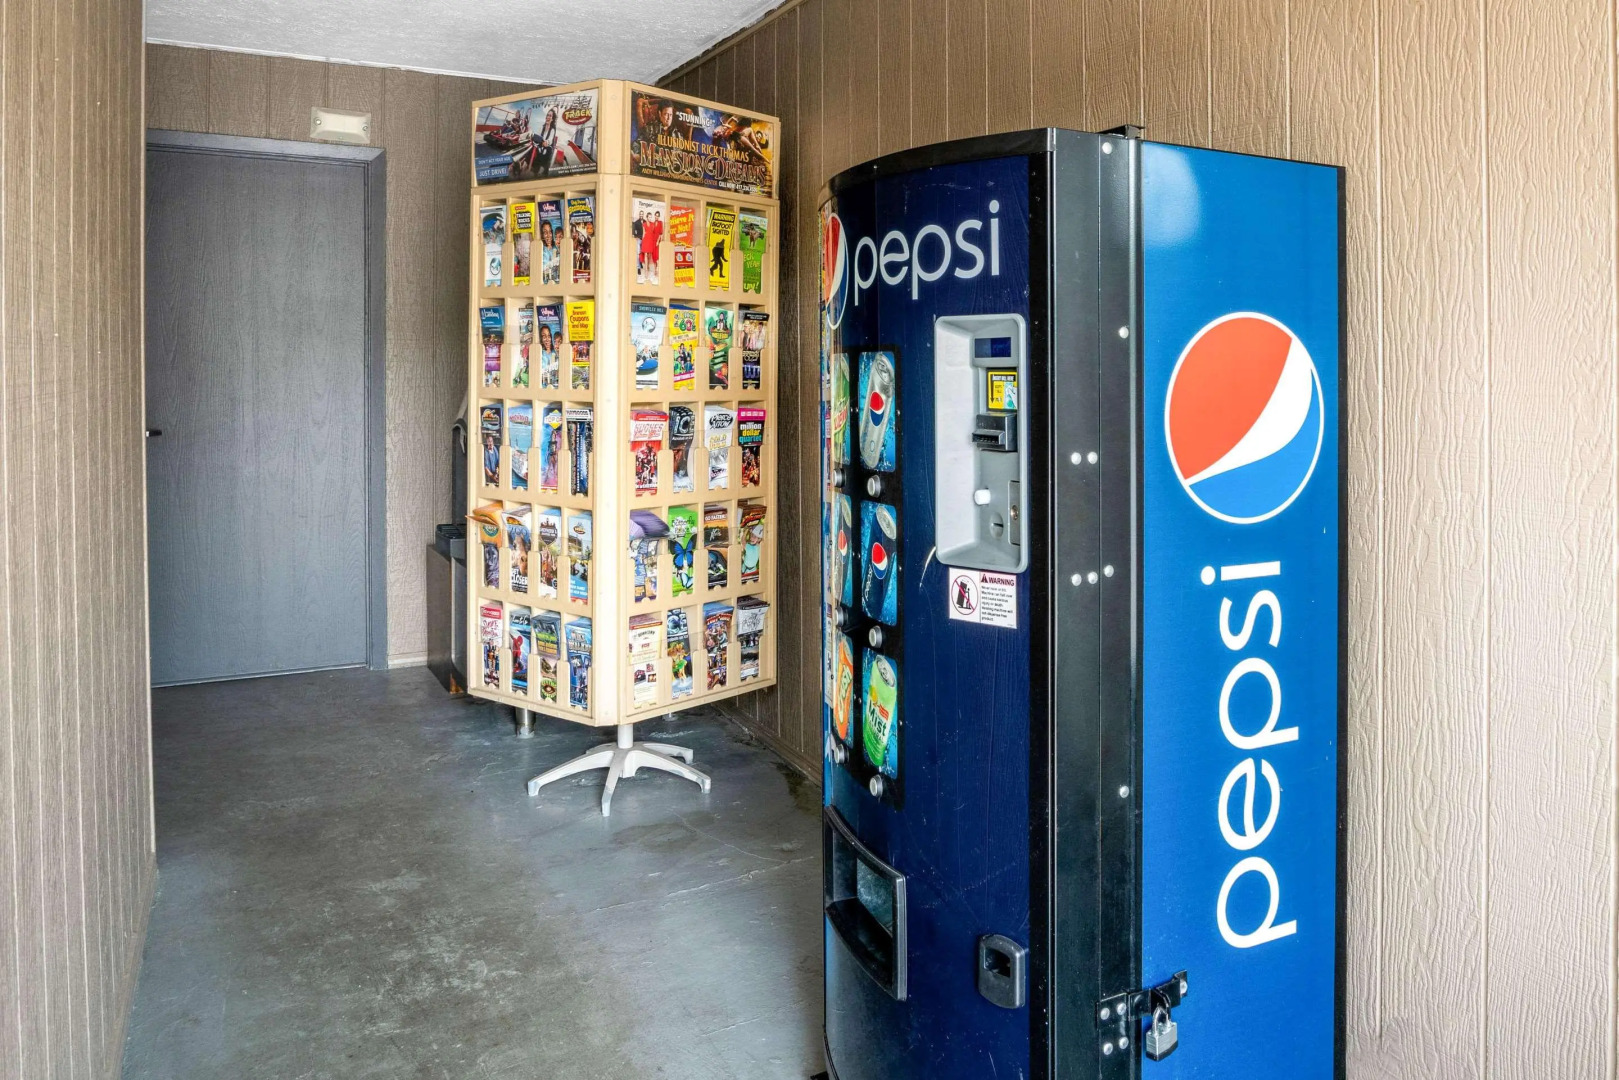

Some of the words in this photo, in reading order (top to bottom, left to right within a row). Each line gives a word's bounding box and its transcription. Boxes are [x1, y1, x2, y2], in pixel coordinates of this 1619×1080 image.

[657, 134, 700, 153] ILLUSIONIST
[701, 143, 718, 155] RICK
[718, 147, 750, 162] THOMAS
[713, 212, 735, 222] WARNING
[712, 221, 733, 230] BIGFOOT
[712, 228, 730, 236] SIGHTED
[855, 199, 1000, 307] pepsi
[569, 316, 590, 325] Coupons
[740, 423, 762, 431] million
[742, 428, 760, 437] dollar
[738, 435, 762, 445] quartet
[989, 577, 1014, 587] WARNING
[1200, 561, 1300, 949] pepsi
